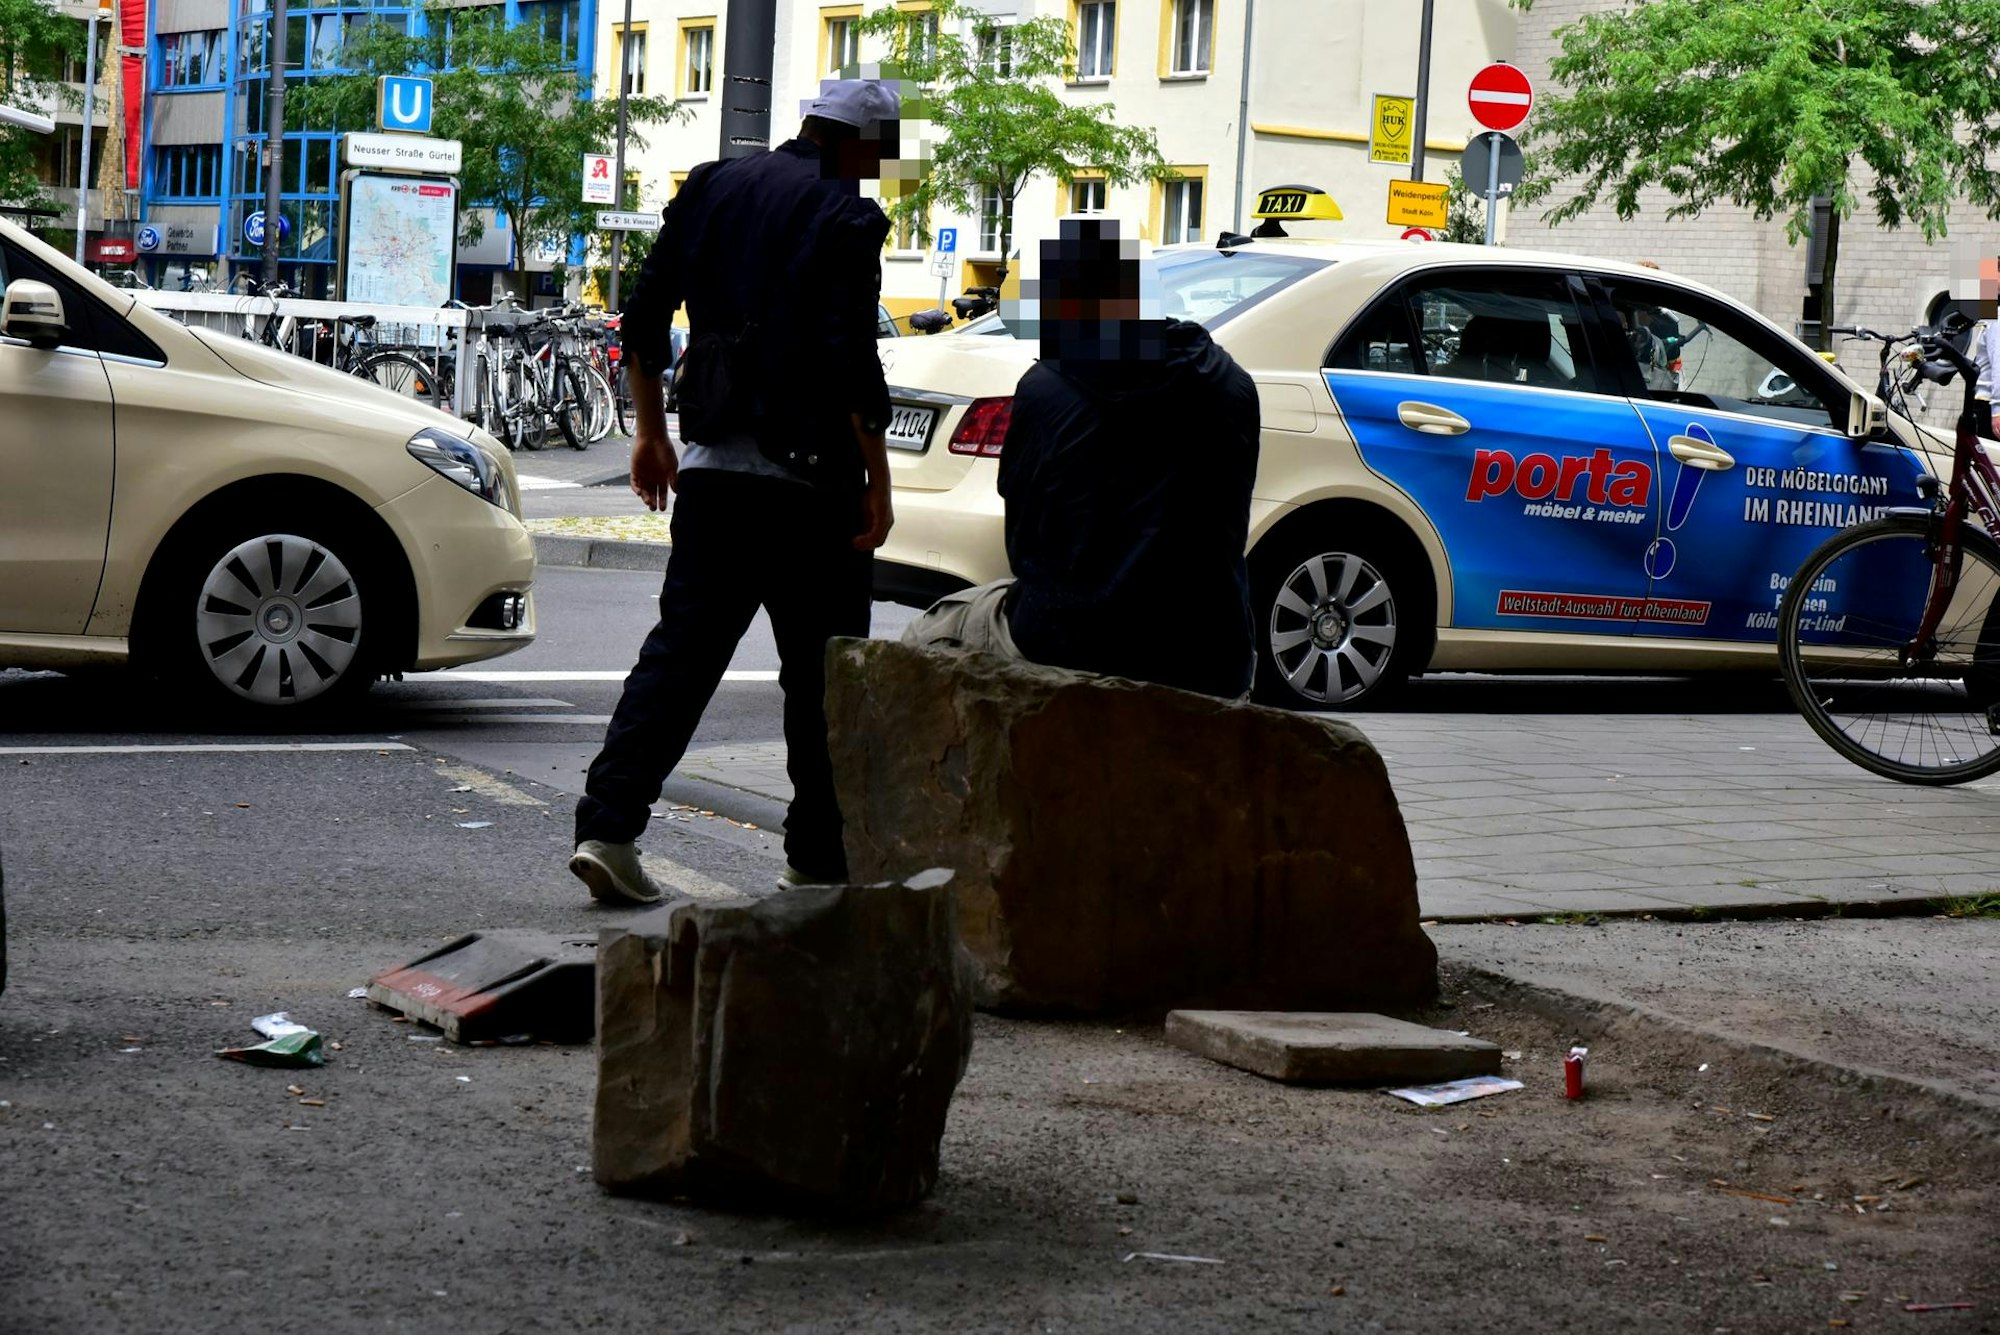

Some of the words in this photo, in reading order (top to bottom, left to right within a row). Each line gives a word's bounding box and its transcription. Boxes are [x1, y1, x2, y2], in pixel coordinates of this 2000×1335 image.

[393, 83, 422, 124] U
[1382, 114, 1405, 126] HUK
[353, 144, 391, 156] Neusser
[395, 147, 424, 159] Straße
[428, 150, 455, 161] Gürtel
[1264, 195, 1301, 213] TAXI
[1393, 189, 1441, 202] Weidenpesc
[1401, 207, 1418, 215] Stadt
[889, 408, 930, 441] 1104
[1465, 448, 1653, 508] porta
[1745, 466, 1776, 488] DER
[1780, 467, 1888, 496] MÖBELGIGANT
[1523, 501, 1581, 521] möbel
[1581, 506, 1596, 521] &
[1597, 509, 1646, 525] mehr
[1743, 497, 1769, 523] IM
[1503, 595, 1616, 617] Weltstadt-Auswahl
[1618, 600, 1642, 618] fürs
[1644, 603, 1706, 621] Rheinland
